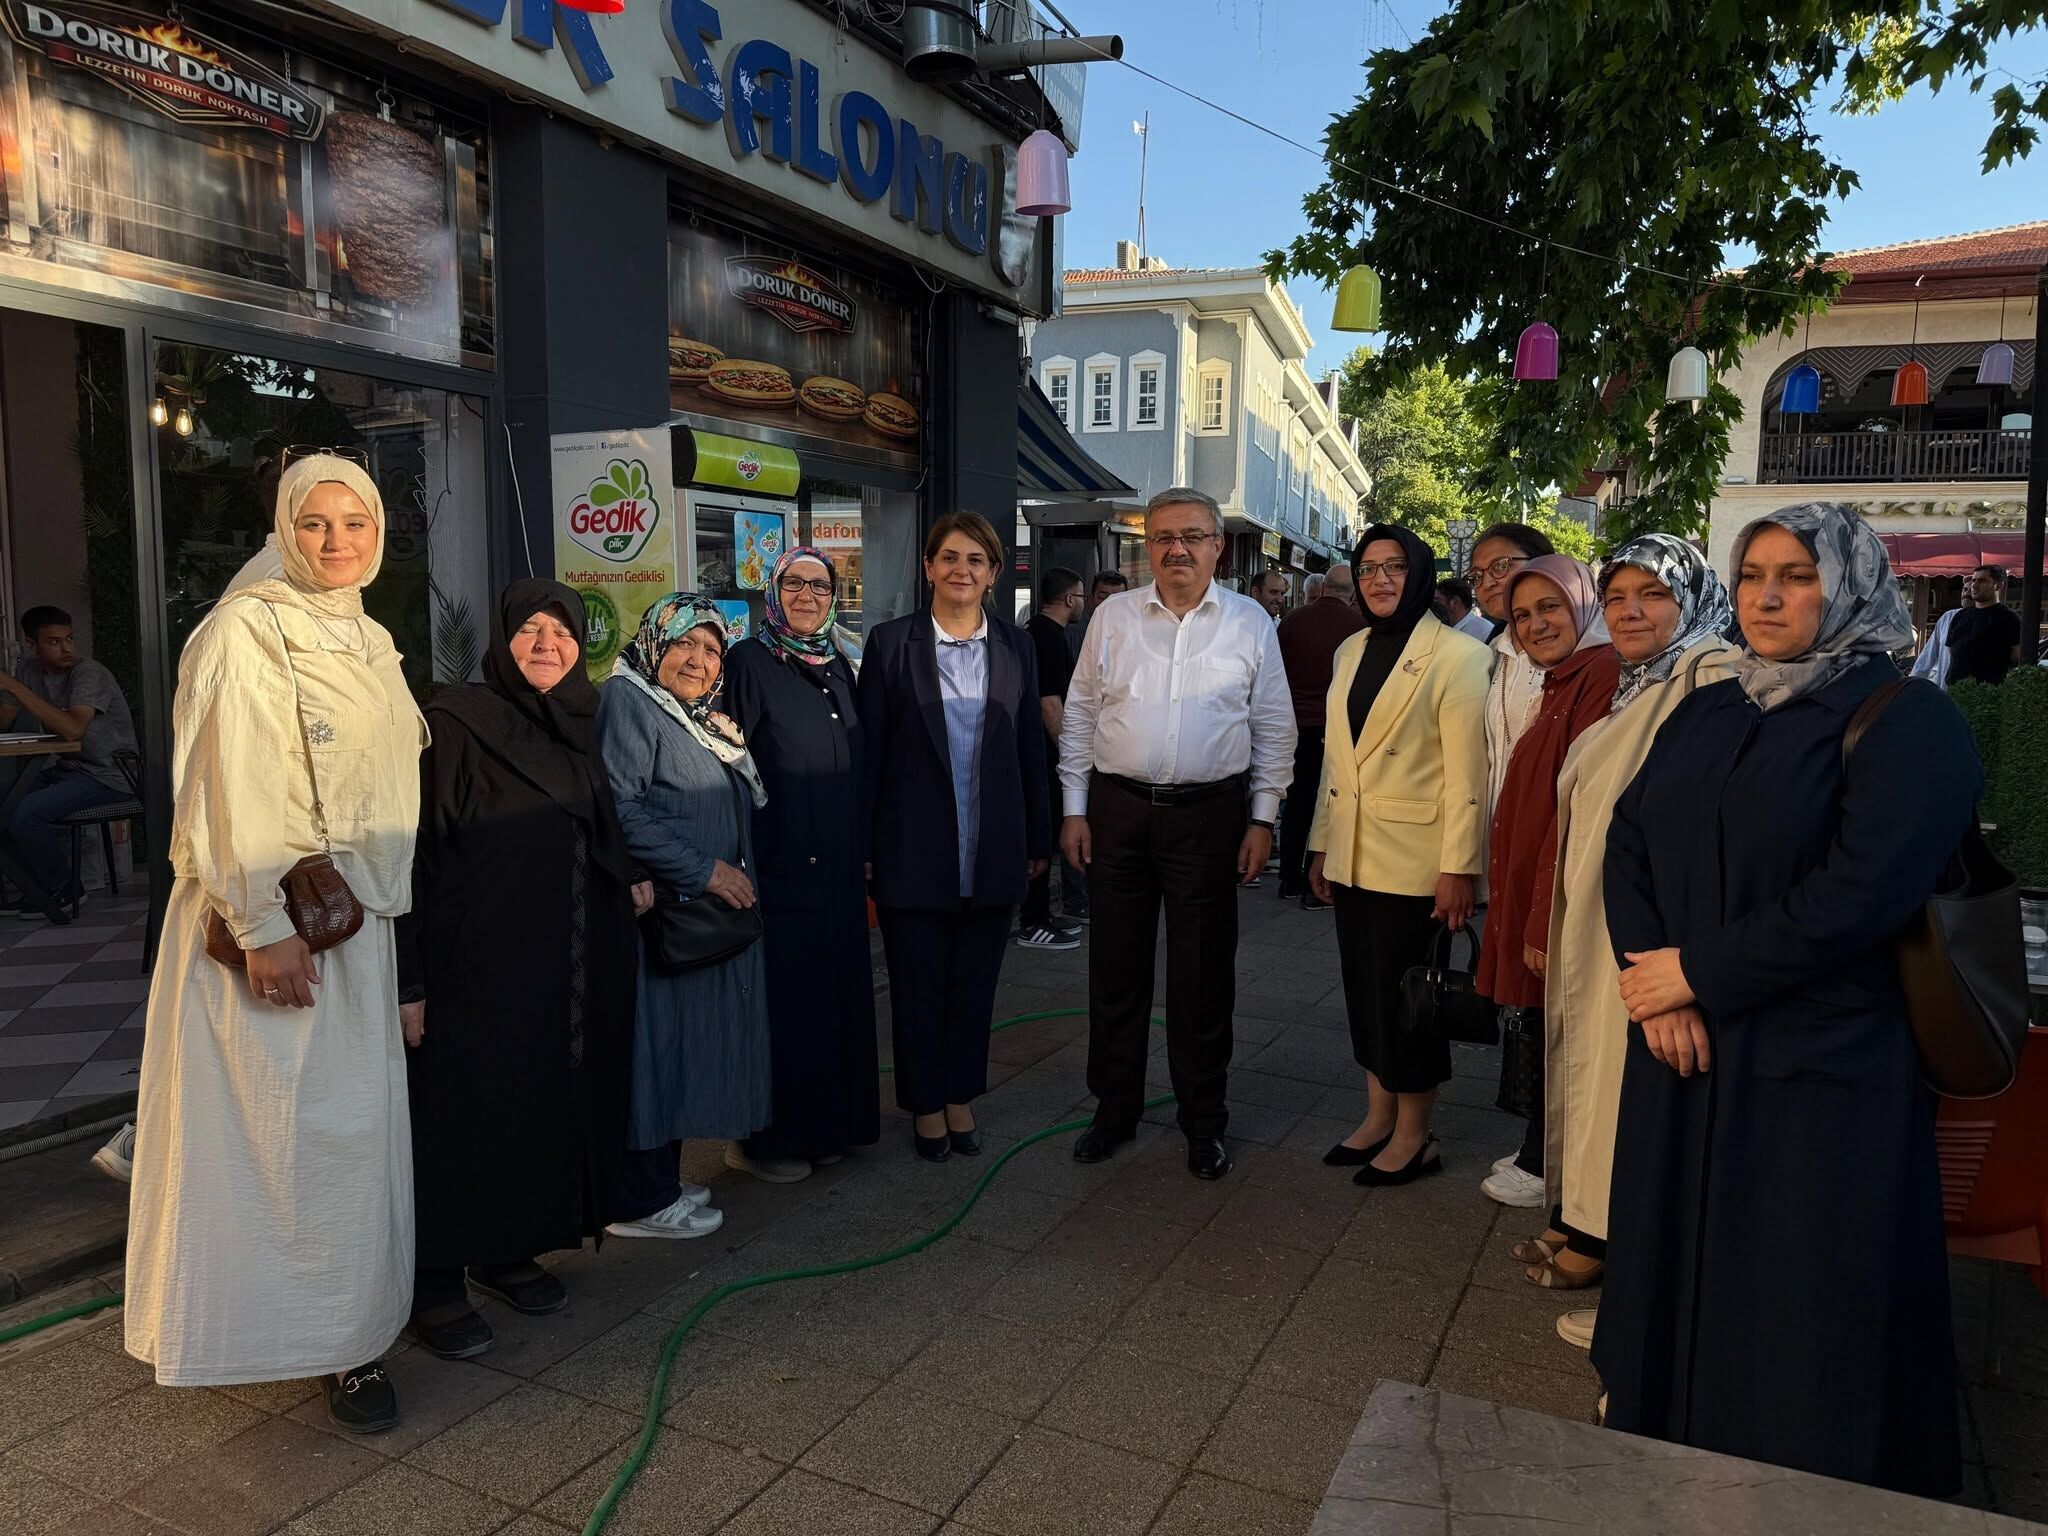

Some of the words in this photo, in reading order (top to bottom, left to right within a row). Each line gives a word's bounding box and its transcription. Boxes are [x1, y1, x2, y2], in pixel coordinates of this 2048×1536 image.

[21, 2, 172, 74] DORUK
[177, 55, 309, 126] DÖNER
[76, 53, 147, 83] LEZZETİN
[153, 77, 203, 102] DORUK
[208, 91, 268, 126] NOKTASI!
[660, 0, 988, 256] SALONU
[736, 266, 796, 299] DORUK
[800, 287, 850, 321] DÖNER
[738, 459, 760, 473] Gedik
[570, 500, 648, 535] Gedik
[792, 522, 862, 538] vdafon
[565, 571, 624, 585] Mutfağınızın
[625, 570, 665, 583] Gediklisi
[587, 616, 610, 634] LAL
